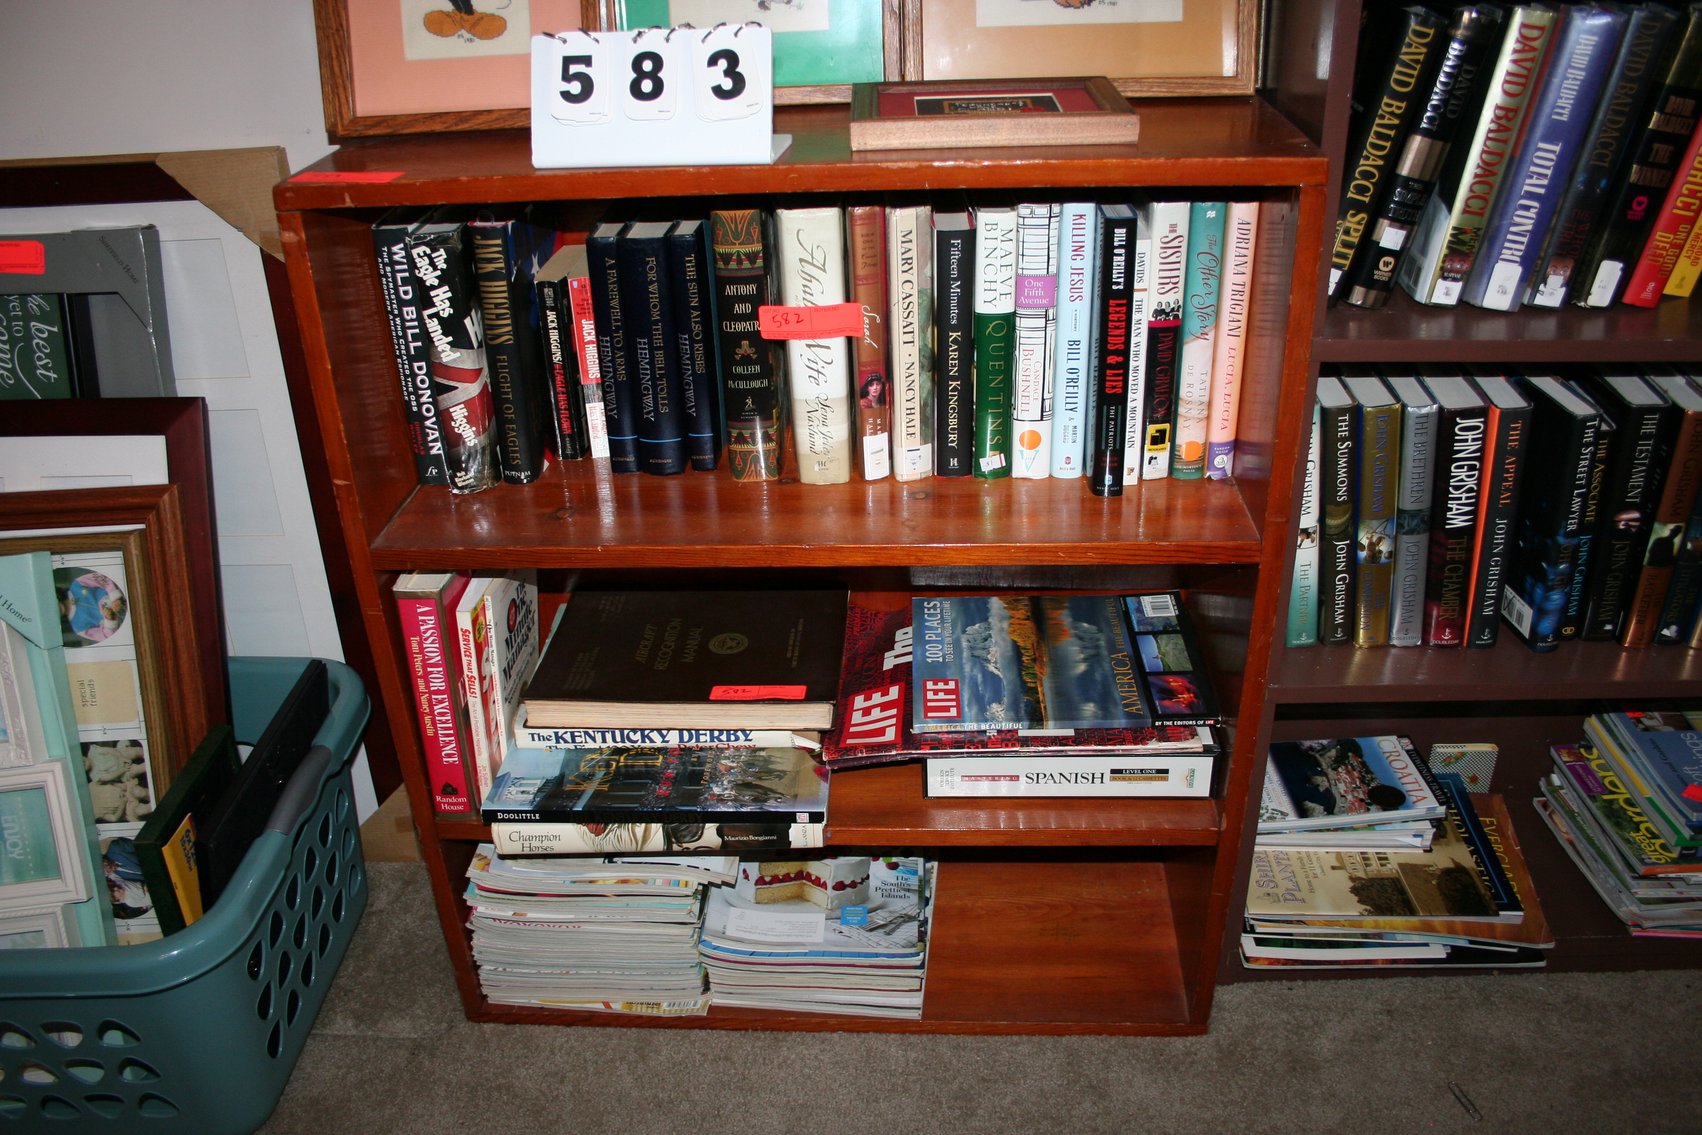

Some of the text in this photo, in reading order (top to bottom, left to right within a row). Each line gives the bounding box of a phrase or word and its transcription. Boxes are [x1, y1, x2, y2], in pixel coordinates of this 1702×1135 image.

[560, 49, 747, 105] 5 8 3
[1420, 37, 1468, 131] BALDACCI
[1500, 21, 1546, 98] DAVID
[1347, 24, 1435, 204] DAVID BALDACCI
[1590, 82, 1638, 168] BALDACCI
[1462, 103, 1520, 217] BALDACCI
[1521, 141, 1562, 196] TOTAL
[431, 248, 448, 269] The
[982, 221, 999, 308] BINCHY
[998, 228, 1014, 301] MAEVE
[1069, 213, 1087, 303] KILLING JESUS
[1113, 227, 1127, 247] BILL
[1136, 252, 1147, 284] DAVIDS
[1157, 234, 1185, 296] SISTERS
[382, 246, 403, 336] THE SPYMASTER WHO
[411, 245, 454, 318] Eagle Has
[474, 235, 514, 346] JACK HIGGINS
[725, 283, 758, 296] ANTONY
[1018, 296, 1050, 305] Avenue
[1024, 279, 1044, 288] One
[1024, 288, 1045, 297] Fifth
[1196, 251, 1220, 299] Other
[12, 321, 25, 337] to
[422, 306, 461, 363] Landed
[546, 309, 558, 329] JACK
[581, 319, 595, 343] JACK
[606, 270, 627, 382] FAREWELL ARMS
[646, 257, 669, 414] FOR WHOM THE BELL TOLLS
[684, 254, 706, 375] THE SUN ALSO RISES
[733, 302, 752, 315] AND
[771, 311, 805, 330] 582
[861, 304, 881, 349] Sarah
[900, 229, 917, 440] MARY CASSATT NANCY HALE
[1220, 217, 1252, 431] ADRIANA TRIGIANI LUCIA
[30, 321, 59, 383] best
[391, 243, 443, 455] WILD BILL DONOVAN
[585, 343, 601, 379] HIGGINS
[678, 332, 697, 417] HEMINGWAY
[732, 364, 761, 375] COLLEEN
[947, 239, 962, 450] Fifteen Minutes KAREN KINGSBURY
[1064, 339, 1082, 413] BILL O'REILLY
[1105, 298, 1128, 395] LEGENDS LIES
[1127, 298, 1144, 449] THE MAN WHO MOVED MOUNTAIN
[599, 336, 618, 420] HEMINGWAY
[636, 337, 655, 422] HEMINGWAY
[985, 319, 1007, 445] QUENTINS
[1021, 348, 1035, 415] BUSHNELL
[1183, 382, 1195, 431] ROSNAY
[1196, 370, 1208, 423] TATIANA
[449, 403, 478, 447] Higgins
[496, 355, 522, 465] FLIGHT OF EAGLES
[1445, 417, 1486, 530] JOHN GRISHAM
[1566, 417, 1599, 532] THE STREET LAWYER
[1624, 411, 1660, 504] THE TESTAMENT
[1334, 413, 1352, 625] THE SUMMONS JOHN GRISHAM
[1400, 414, 1429, 632] THE BRETHREN JOHN GRISHAM
[1482, 420, 1523, 616] THE APPEAL JOHN GRISHAM
[1567, 437, 1610, 617] THE ASSOCIATE JOHN GRISHAM
[924, 600, 943, 663] 100 PLACES
[943, 600, 953, 654] SEE LIFETIME
[418, 615, 459, 765] PASSION FOR EXCELLENCE
[460, 627, 478, 699] SERVICE THAT SELLS!
[1111, 651, 1144, 715] AMERICA
[421, 715, 434, 737] Austin
[846, 685, 900, 744] LIFE
[926, 680, 958, 717] LIFE
[980, 721, 1023, 729] BEAUTIFUL
[528, 730, 754, 745] The KENTUCKY DERBY
[436, 795, 467, 803] Random
[1025, 772, 1106, 785] SPANISH
[1377, 740, 1428, 805] CROATIA
[440, 803, 465, 811] House
[497, 812, 541, 820] DOOLITTLE
[509, 830, 562, 844] Champion
[724, 834, 749, 842] Maurizio
[521, 842, 554, 853] Horses
